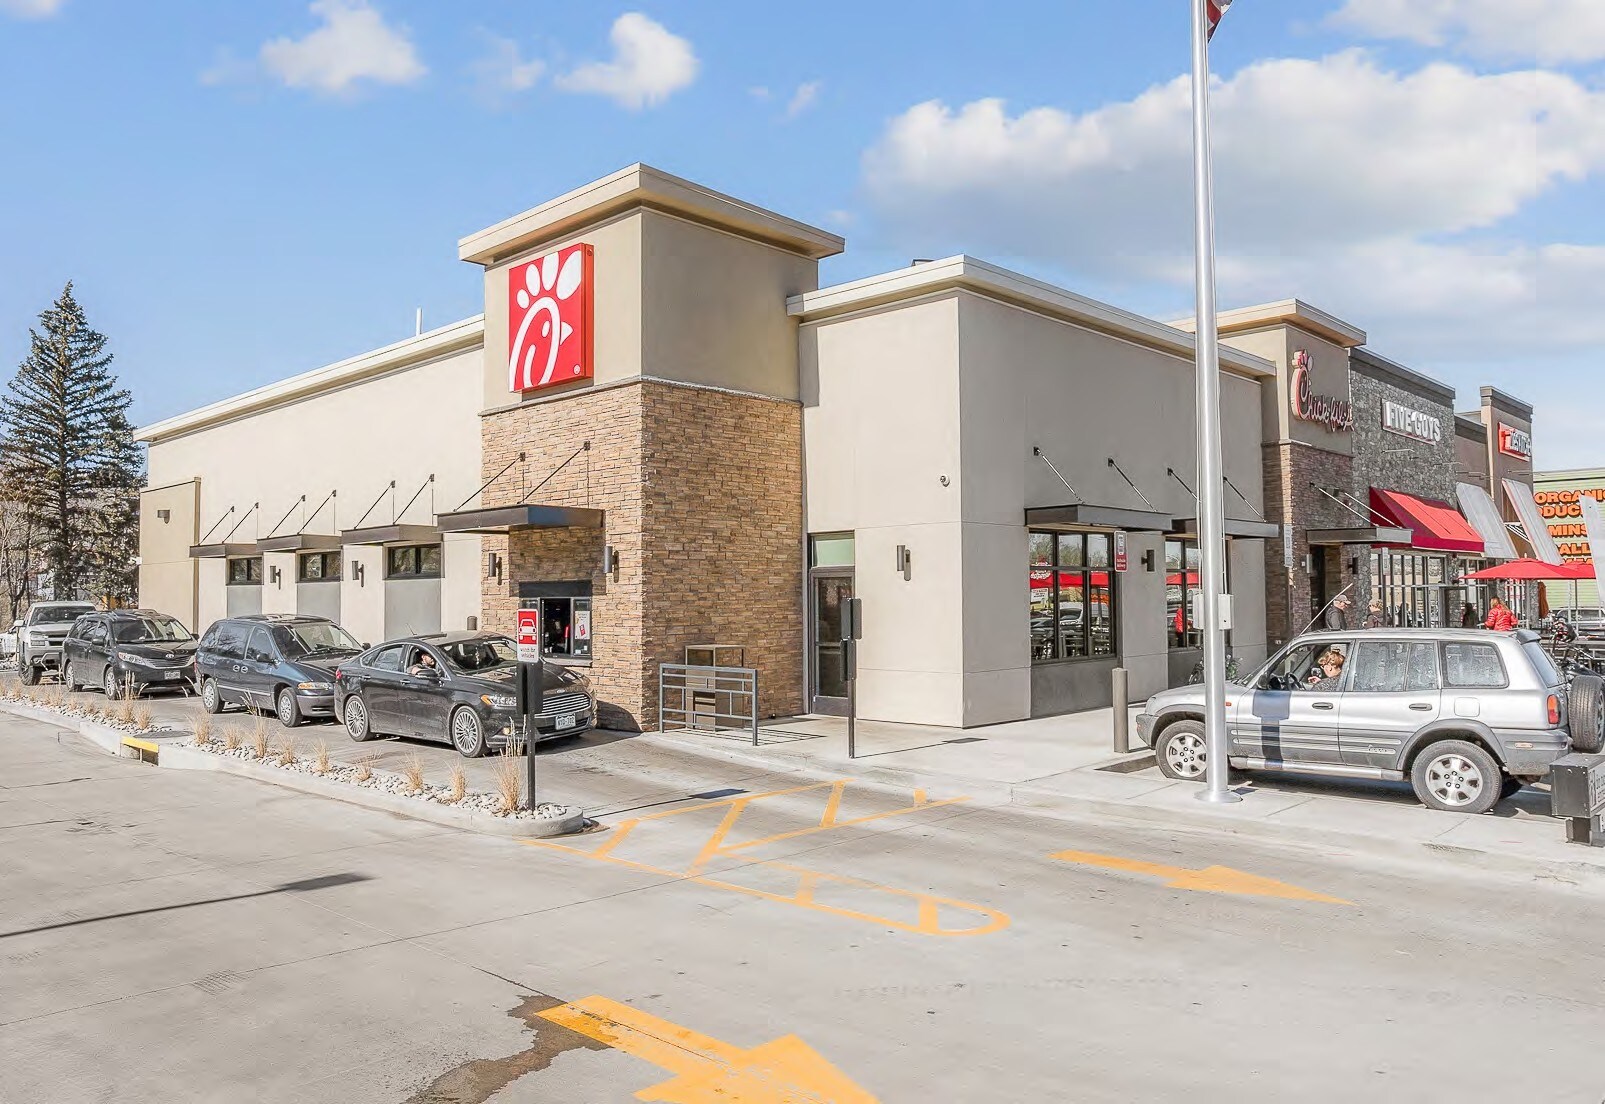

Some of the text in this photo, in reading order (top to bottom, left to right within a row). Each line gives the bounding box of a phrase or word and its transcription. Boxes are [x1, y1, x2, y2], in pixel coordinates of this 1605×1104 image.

[1385, 401, 1440, 441] FIVE GUYS
[1534, 489, 1605, 505] ORGANI
[1538, 504, 1583, 518] DUC
